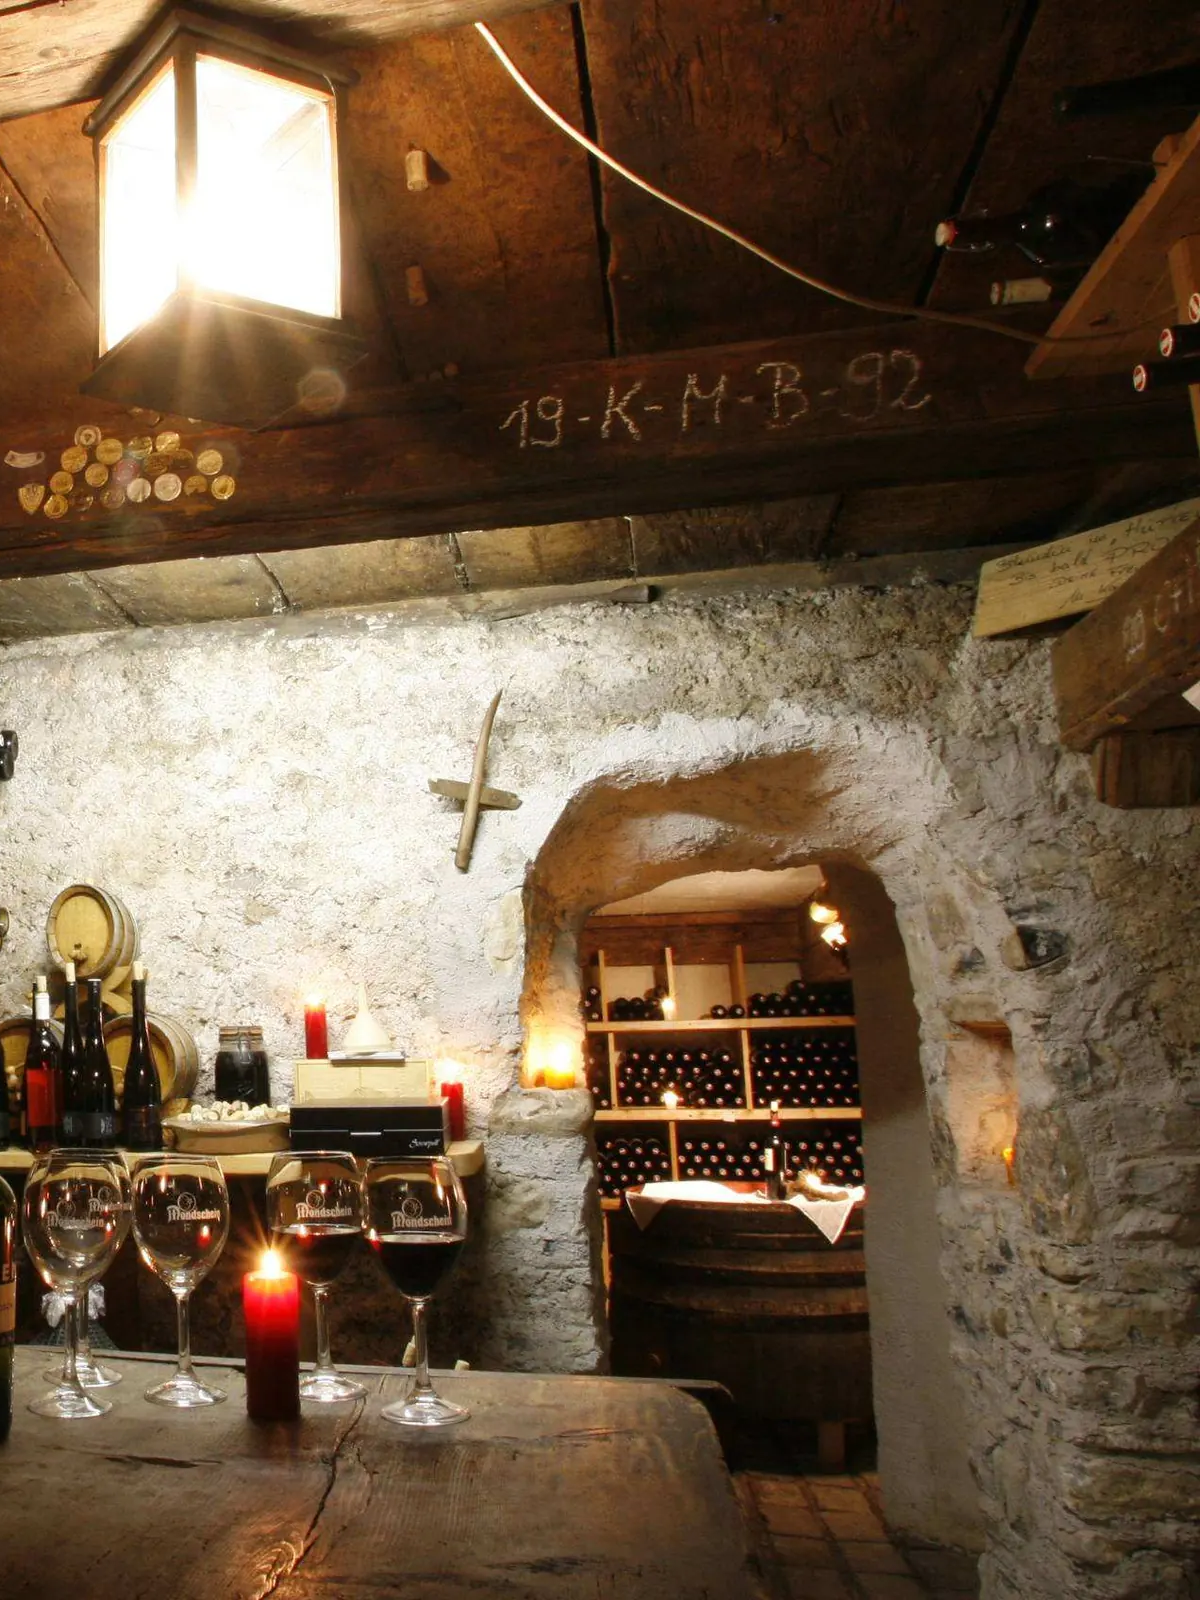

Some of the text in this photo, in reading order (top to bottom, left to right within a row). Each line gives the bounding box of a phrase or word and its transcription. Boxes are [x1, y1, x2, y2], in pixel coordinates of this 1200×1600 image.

[166, 1204, 221, 1223] Mondschein
[295, 1201, 353, 1219] Mondschein
[390, 1210, 453, 1229] Mondschein
